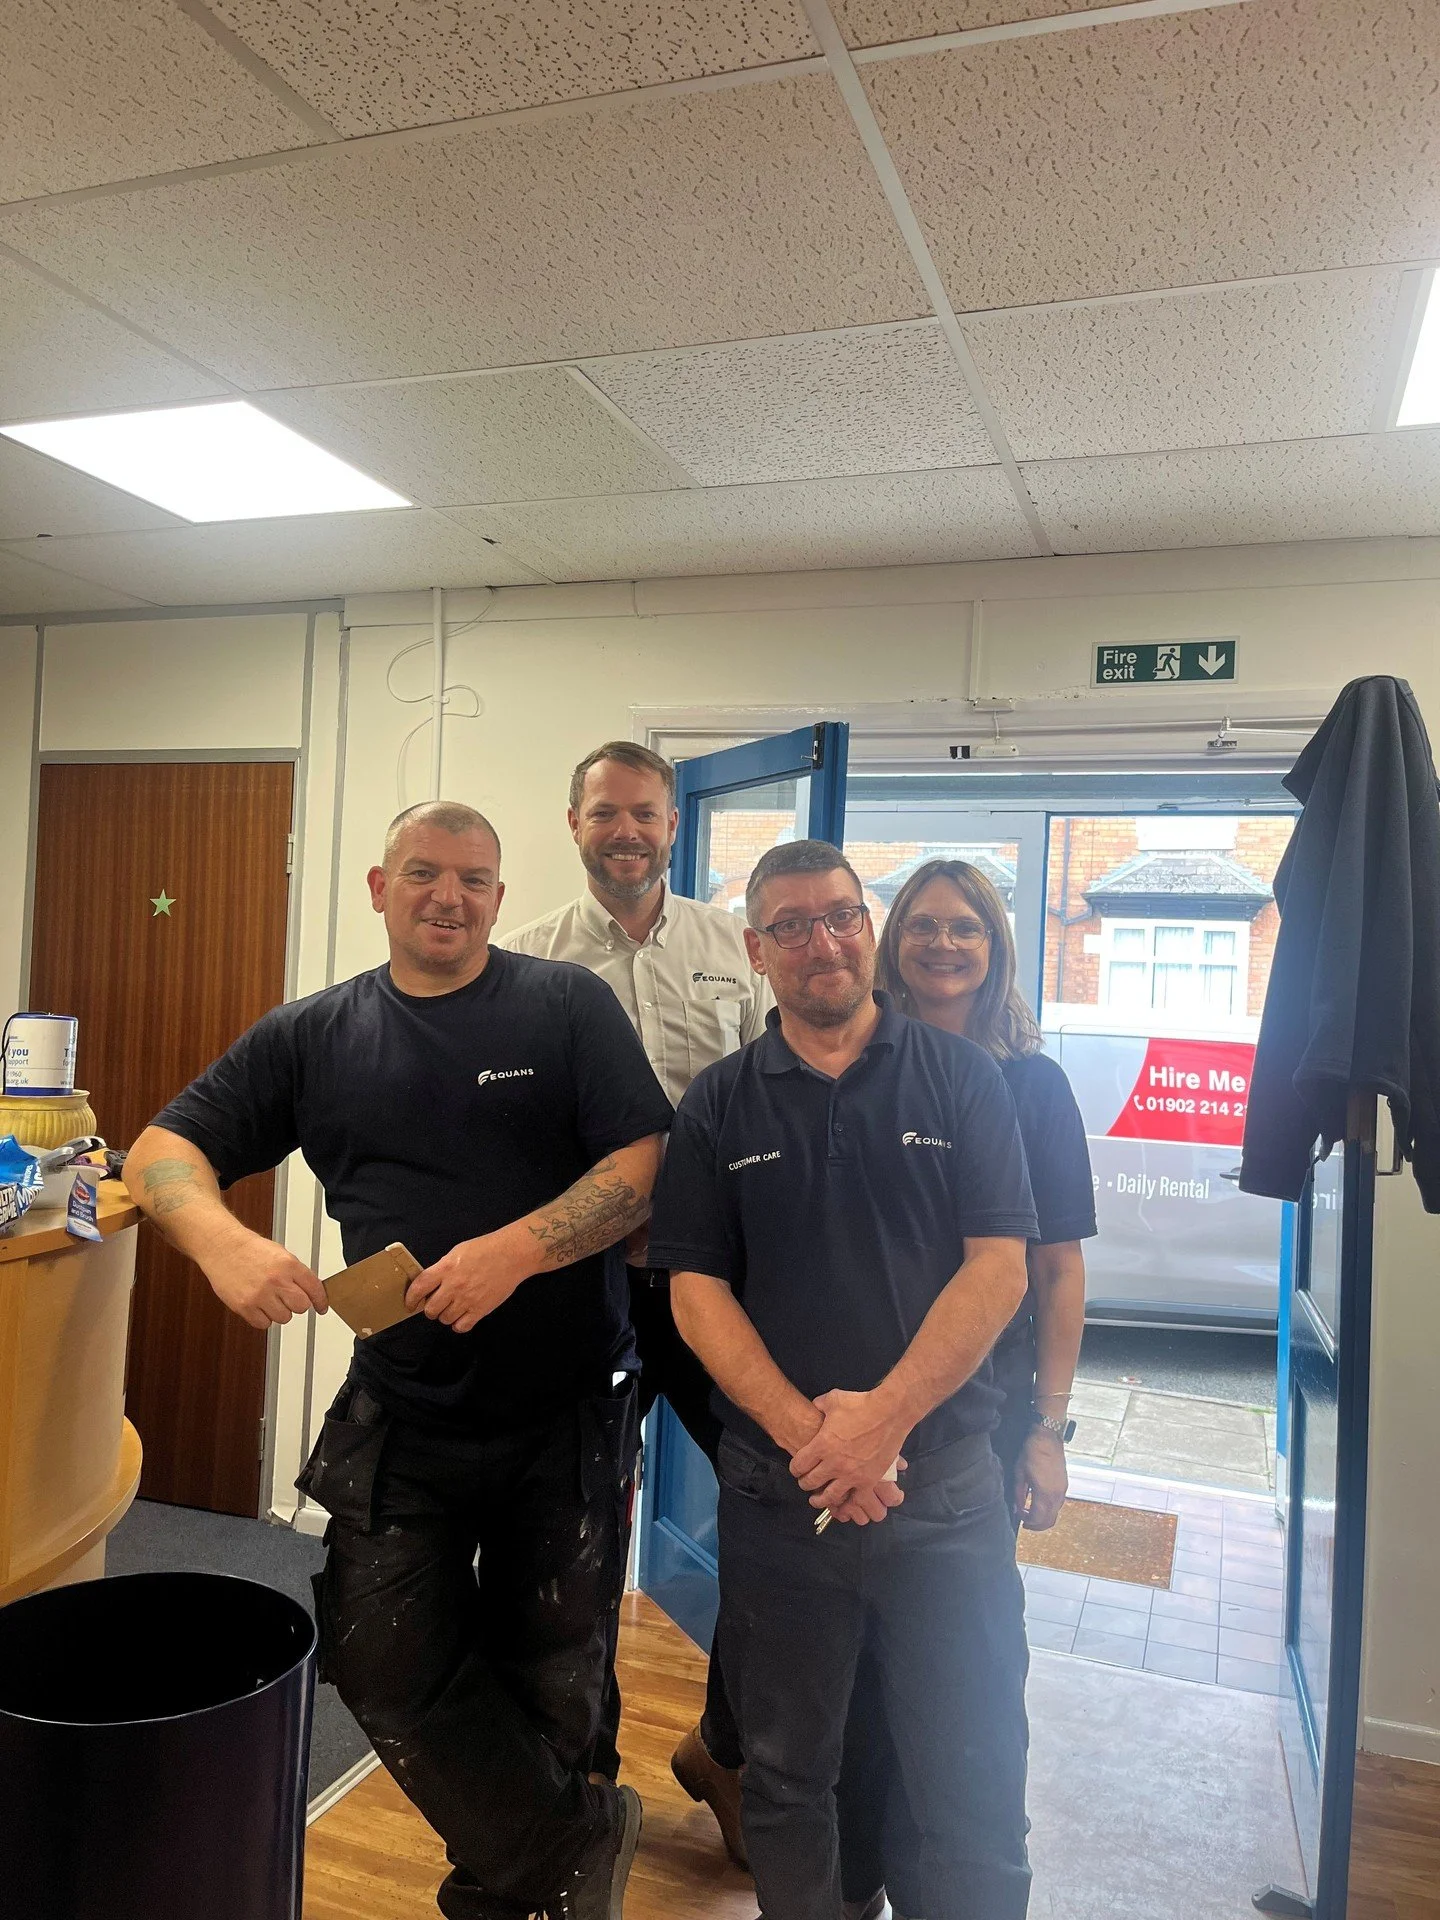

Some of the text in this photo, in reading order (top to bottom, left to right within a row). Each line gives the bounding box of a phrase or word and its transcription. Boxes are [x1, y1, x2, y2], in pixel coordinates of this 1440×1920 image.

[1103, 650, 1137, 665] Fire
[1102, 665, 1135, 680] exit
[702, 976, 737, 984] EQUANS
[11, 1048, 29, 1059] you
[490, 1068, 534, 1081] EQUANS
[1149, 1065, 1246, 1093] Hire Me
[1146, 1096, 1196, 1114] 01902
[1199, 1100, 1230, 1116] 214
[762, 1150, 781, 1161] CARE
[1116, 1172, 1157, 1200] Daily
[1159, 1175, 1210, 1199] Rental
